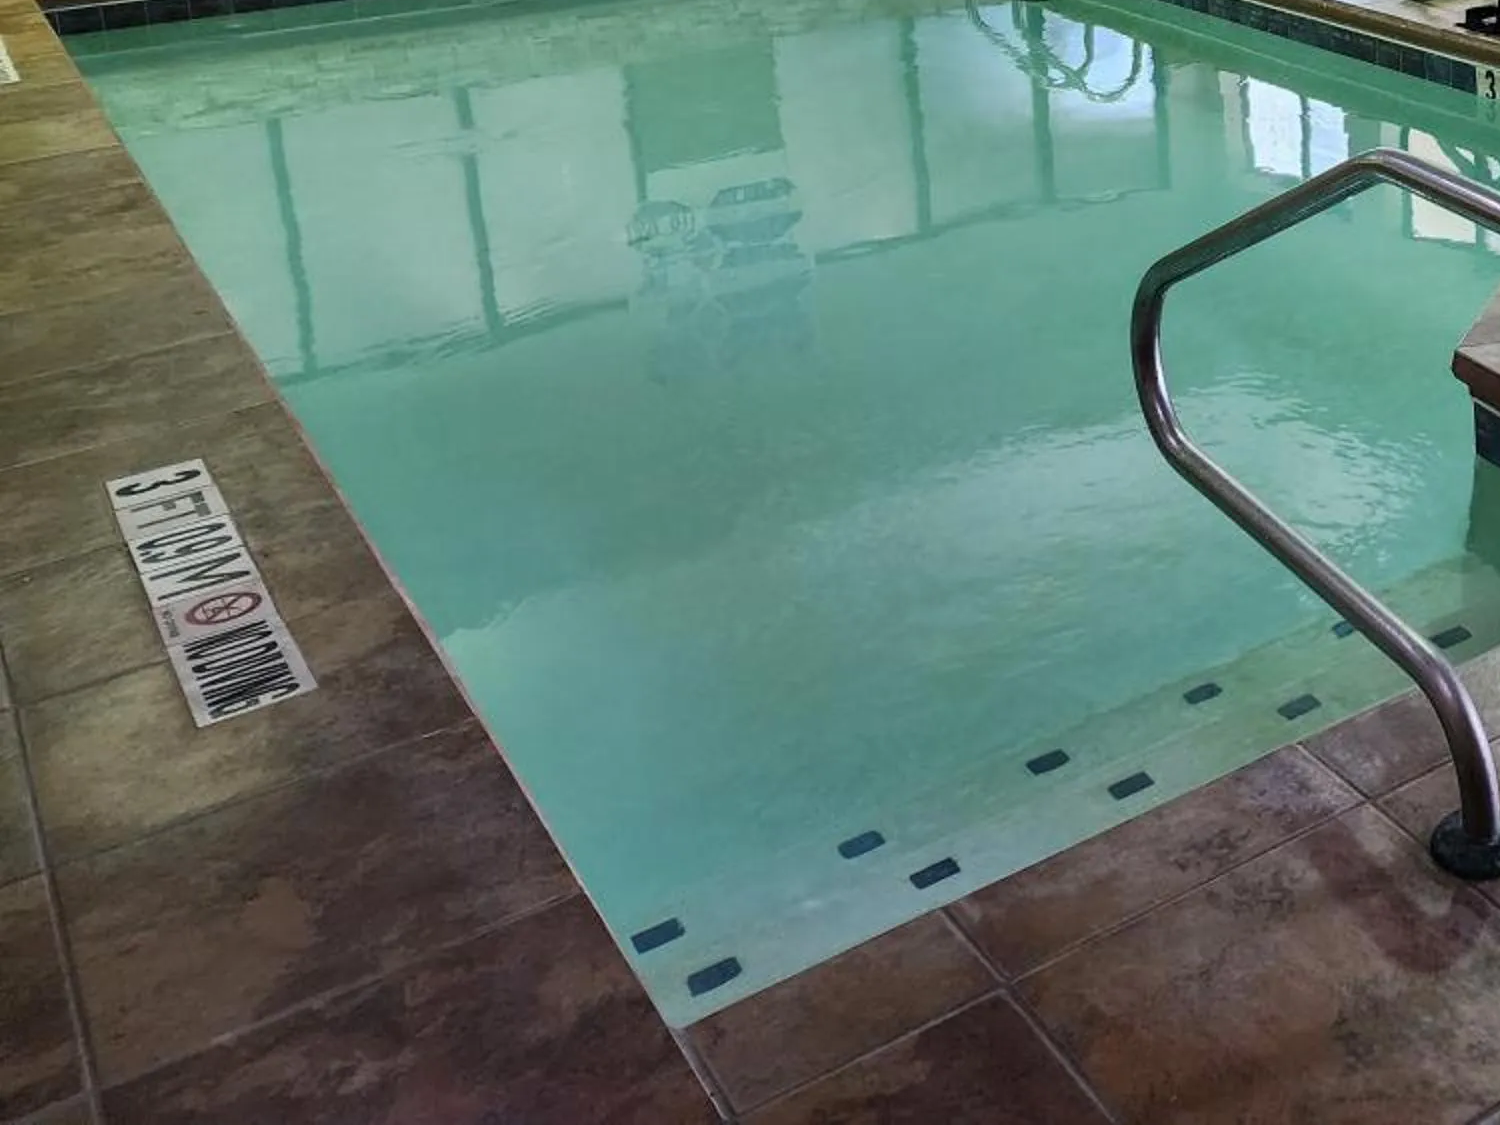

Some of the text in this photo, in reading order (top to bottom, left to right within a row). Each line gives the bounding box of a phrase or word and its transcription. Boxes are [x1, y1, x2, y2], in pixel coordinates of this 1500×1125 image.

[1485, 70, 1496, 99] 3
[116, 468, 201, 497] 3
[130, 490, 211, 530] FT
[149, 552, 251, 601] M
